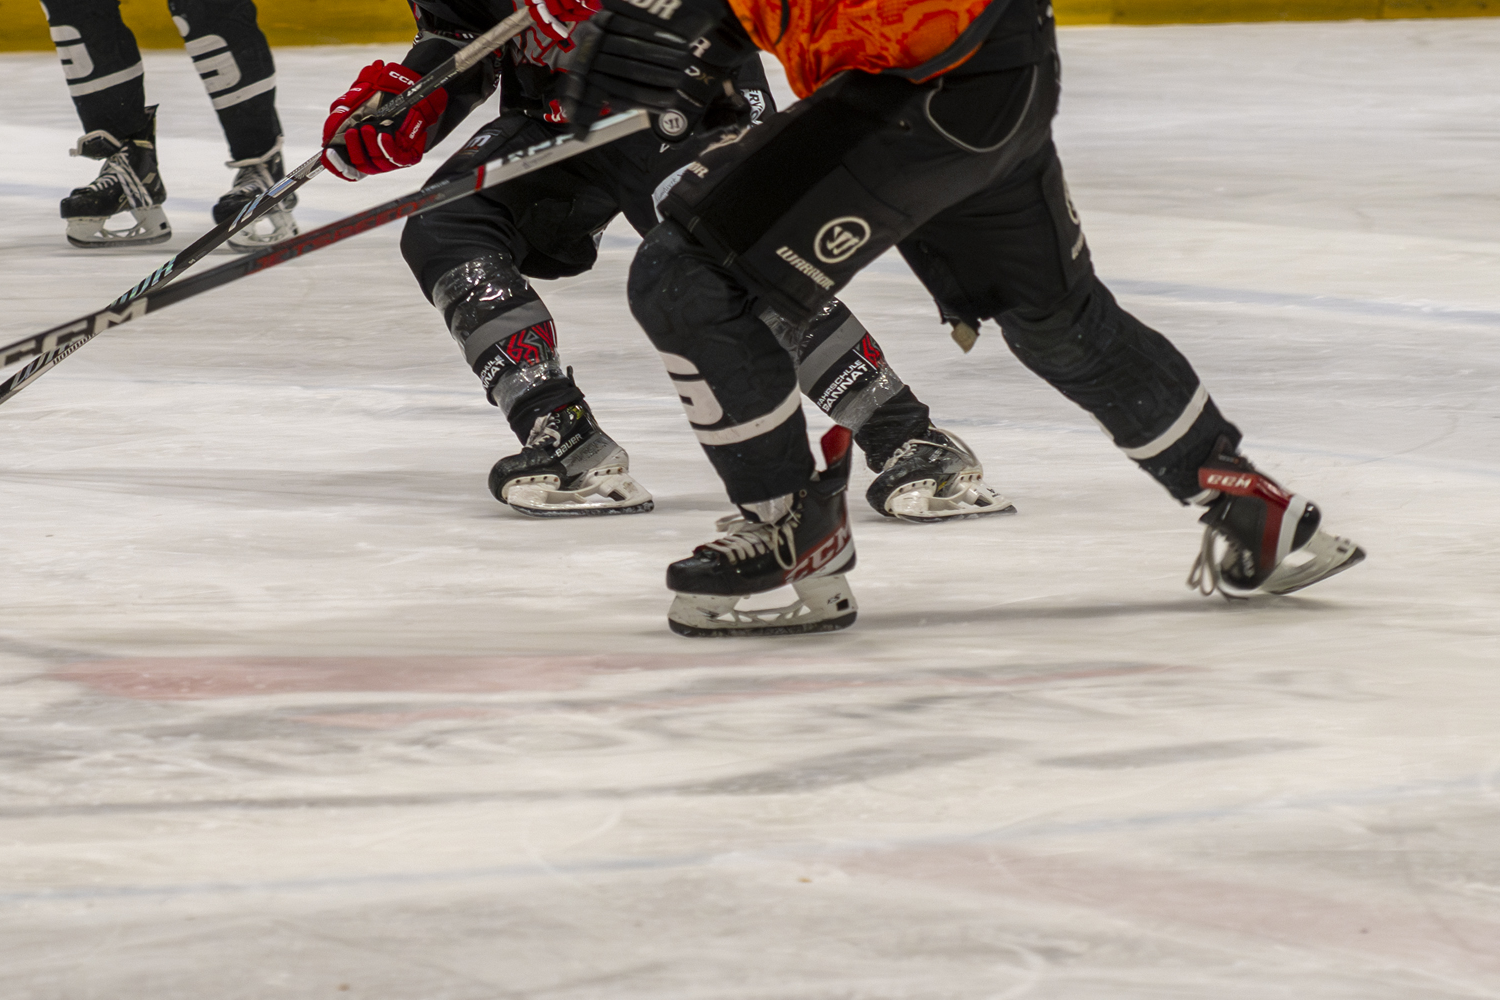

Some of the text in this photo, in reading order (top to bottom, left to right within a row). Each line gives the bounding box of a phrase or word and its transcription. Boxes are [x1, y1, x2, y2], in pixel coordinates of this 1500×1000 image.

[775, 246, 836, 292] WARRIOR
[816, 358, 863, 408] FAHRSCHULE
[554, 433, 583, 458] BAUER
